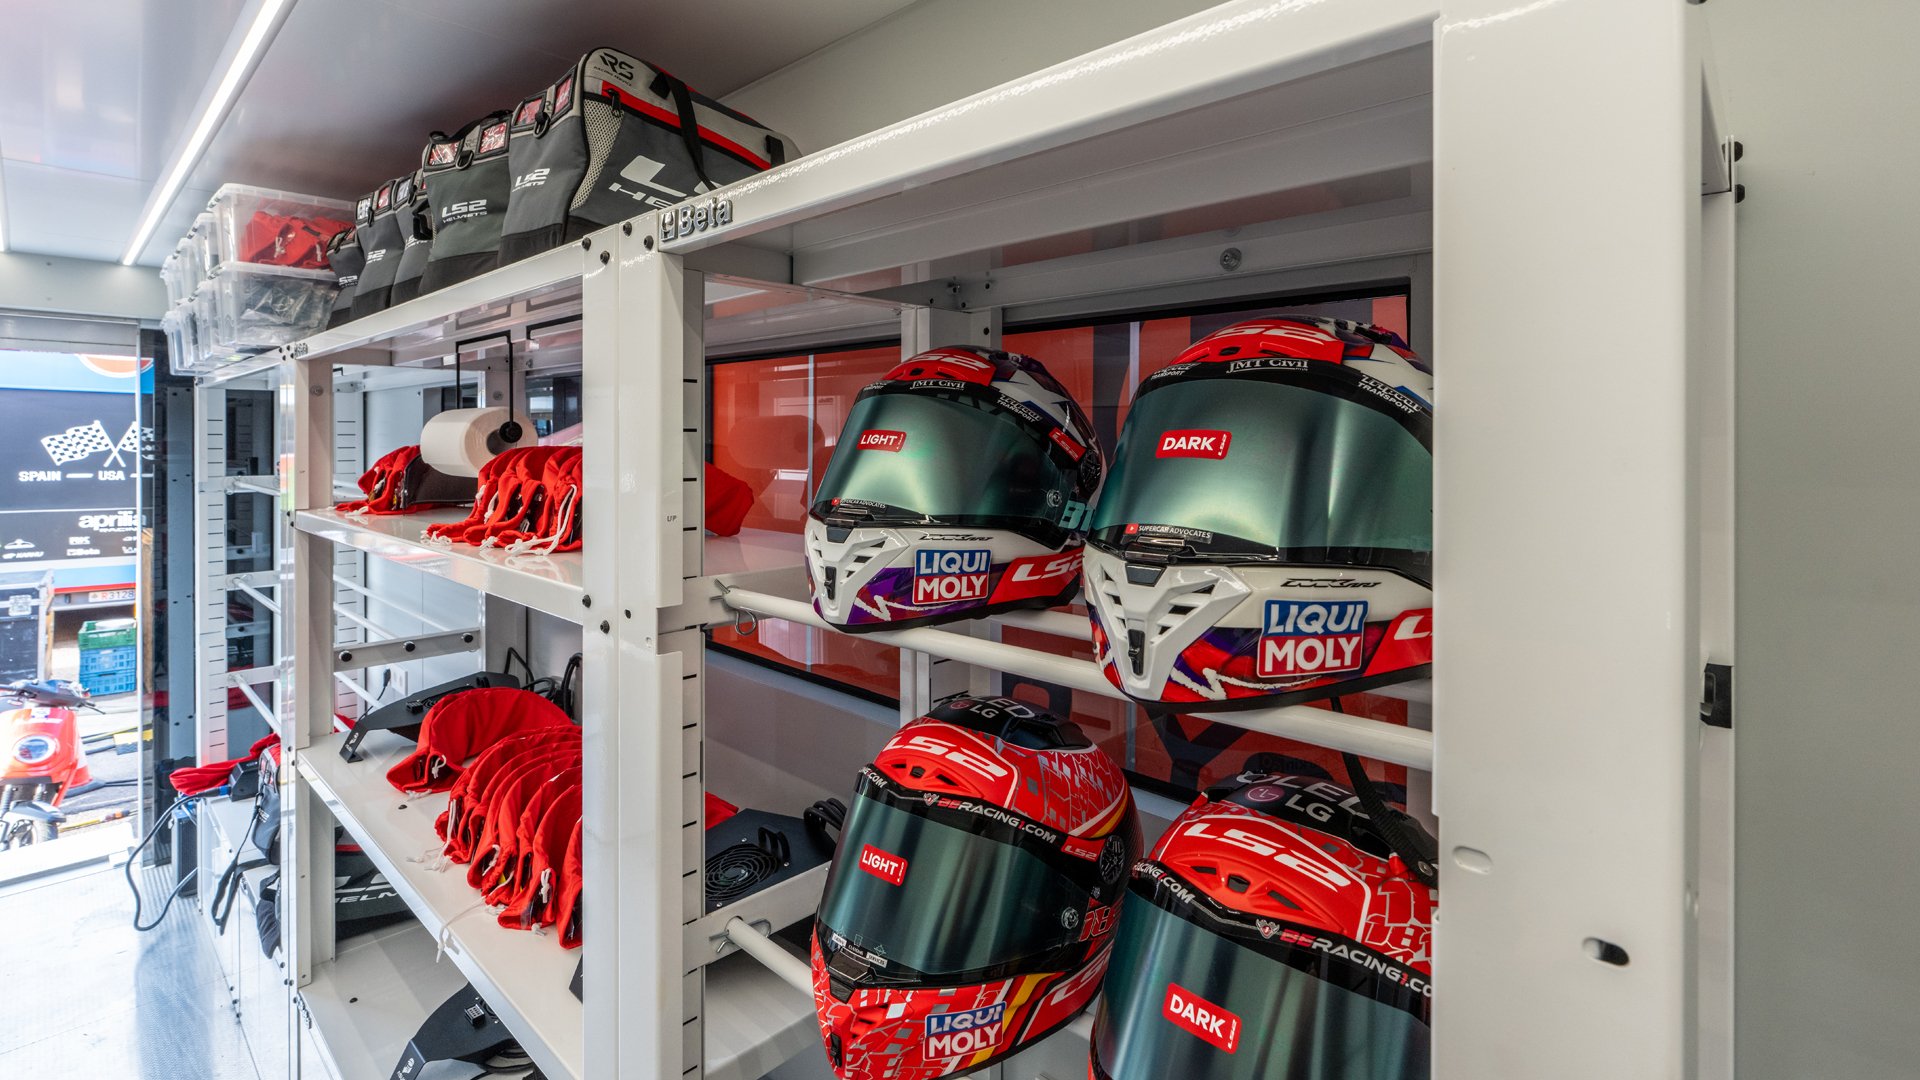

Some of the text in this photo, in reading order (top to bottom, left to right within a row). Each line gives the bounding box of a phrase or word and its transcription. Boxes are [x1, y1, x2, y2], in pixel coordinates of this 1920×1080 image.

[599, 52, 634, 80] RS
[441, 199, 487, 218] LS2
[443, 211, 488, 223] HELMETS
[679, 198, 732, 237] Beta
[338, 275, 358, 285] S2
[1226, 359, 1309, 374] JMT Civil
[909, 380, 935, 390] JMT
[938, 380, 966, 389] Civil
[1358, 381, 1415, 414] TRANSPORT
[997, 399, 1035, 422] TRANSPORT
[860, 434, 898, 446] LIGHT
[1162, 436, 1216, 451] DARK
[18, 470, 126, 482] SPAIN USA
[1138, 525, 1211, 539] SUPERCAR ADVOCATES
[919, 551, 988, 574] LIQUI
[917, 574, 987, 601] MOLY
[1267, 604, 1364, 635] LIQUI
[1264, 636, 1361, 672] MOLY
[969, 704, 999, 718] LG
[882, 735, 1008, 782] LS2
[1285, 794, 1335, 823] LG
[862, 850, 898, 876] LIGHT
[1064, 845, 1097, 860] LS2
[1184, 823, 1351, 893] LS2
[1280, 928, 1432, 998] BERACING1.CO
[930, 1005, 1002, 1035] LIQUI
[1170, 993, 1226, 1038] DARK
[928, 1022, 1002, 1058] MOLY
